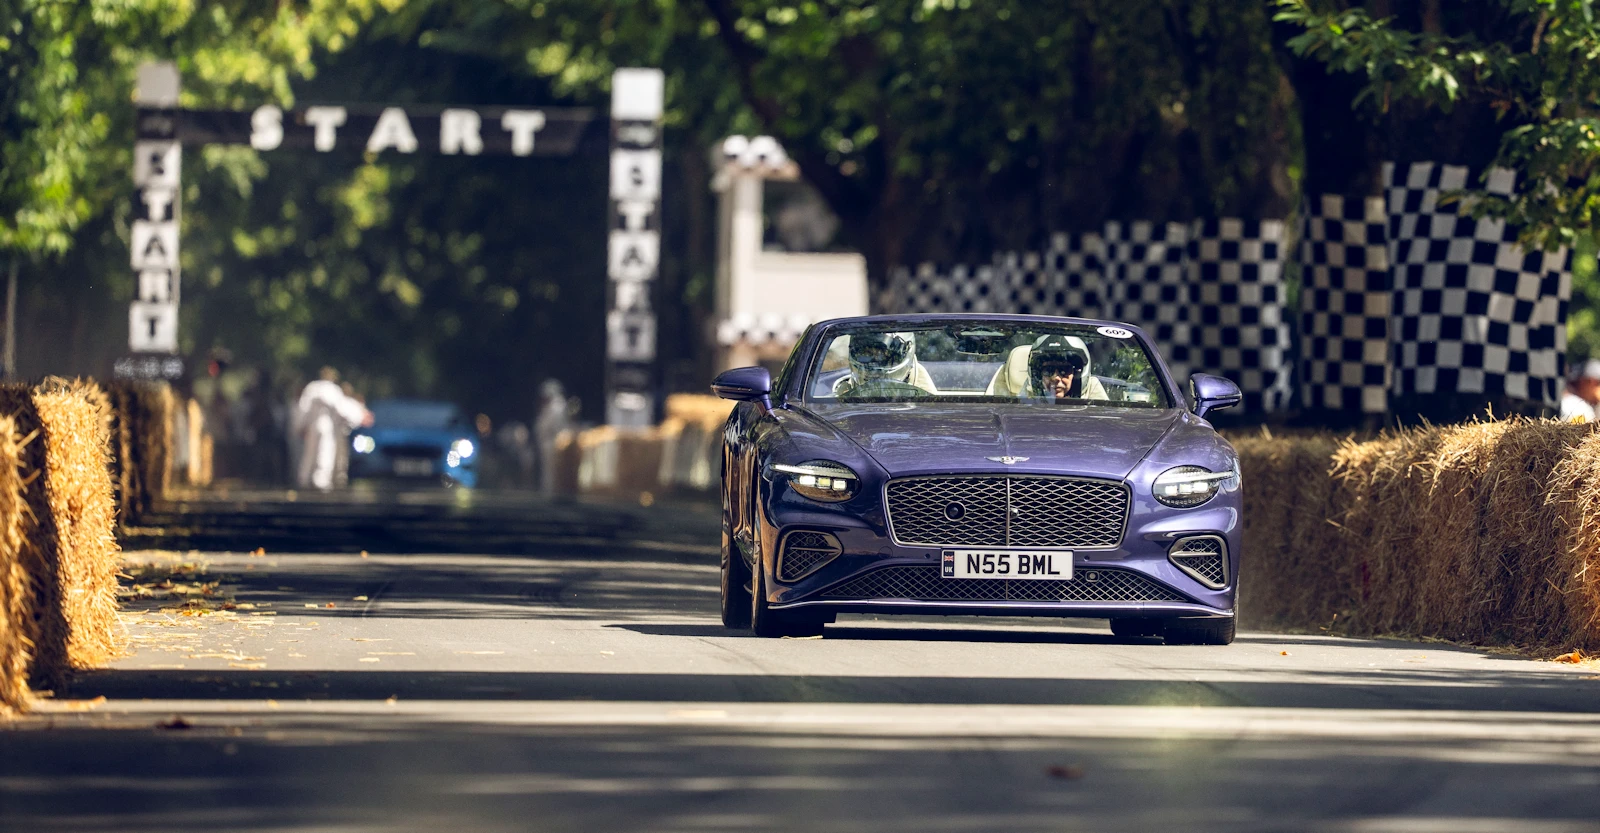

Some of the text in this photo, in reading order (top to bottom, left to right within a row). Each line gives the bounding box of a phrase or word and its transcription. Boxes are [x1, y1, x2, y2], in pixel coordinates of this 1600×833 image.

[250, 104, 546, 156] START
[138, 152, 176, 339] START
[614, 165, 656, 348] START
[1105, 328, 1126, 336] 609
[967, 553, 1060, 575] N55 BML
